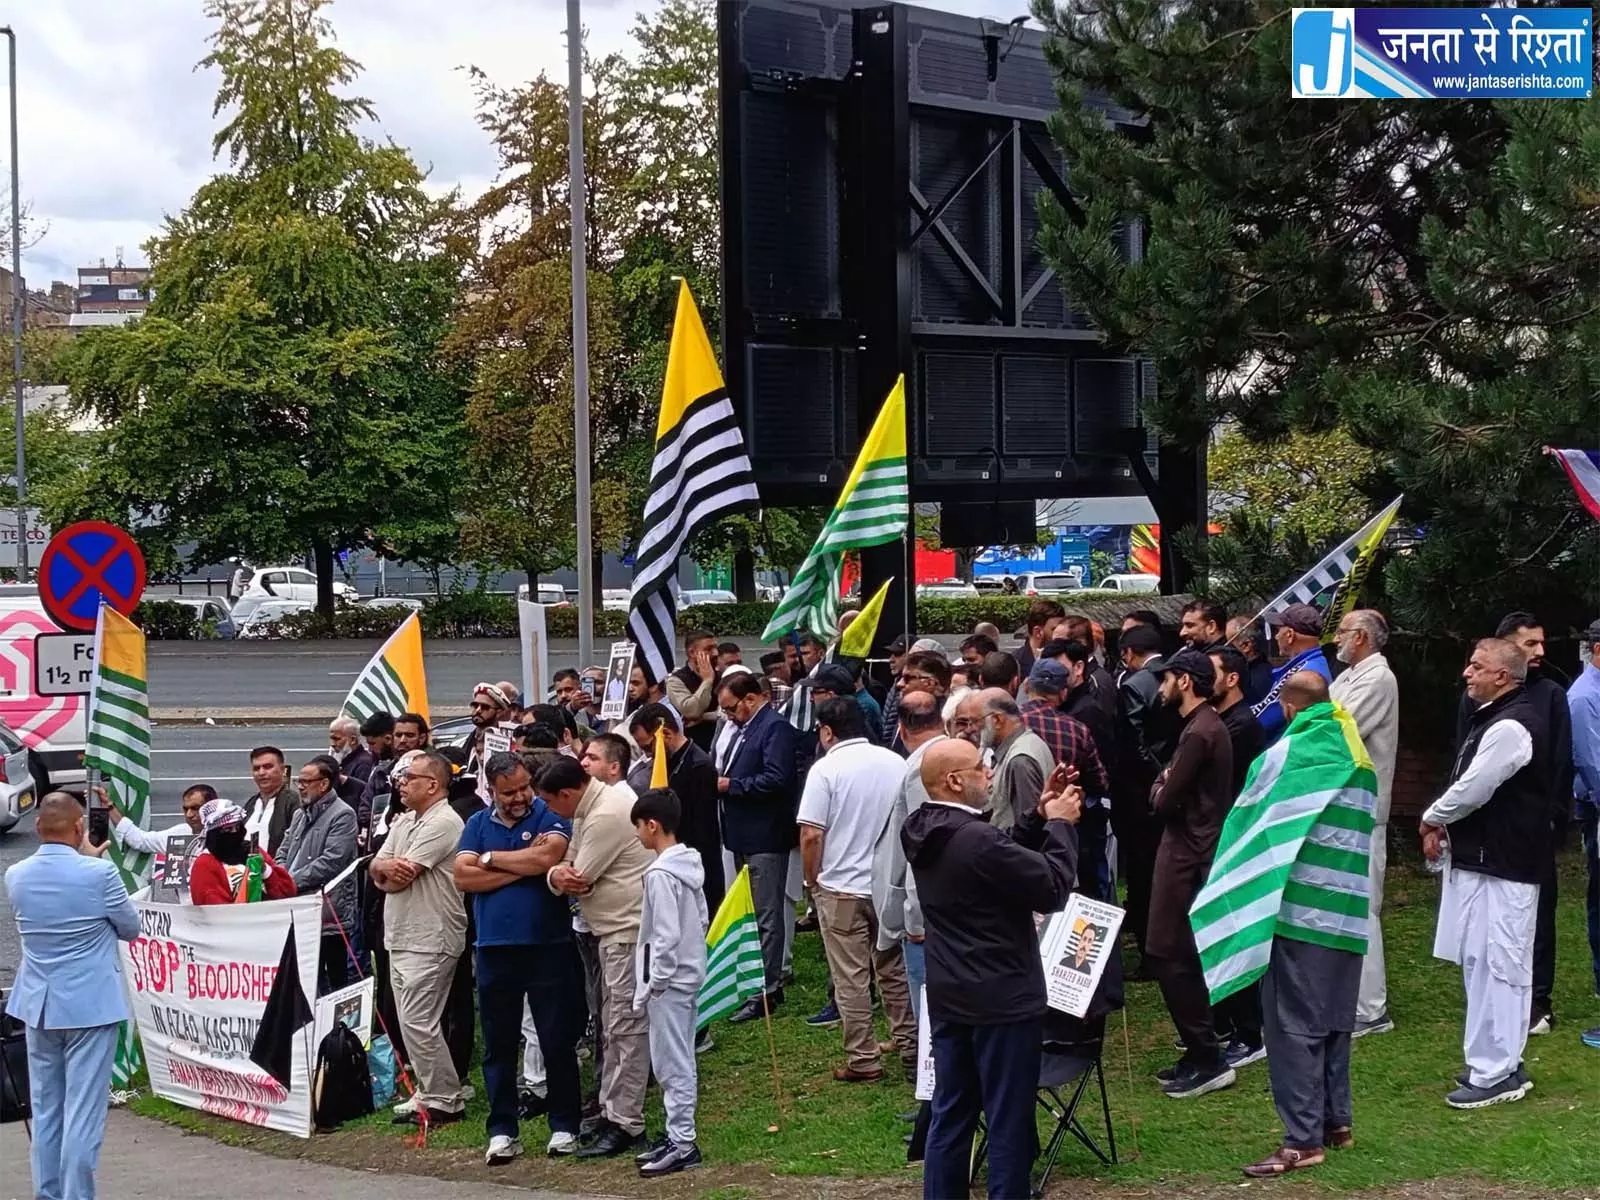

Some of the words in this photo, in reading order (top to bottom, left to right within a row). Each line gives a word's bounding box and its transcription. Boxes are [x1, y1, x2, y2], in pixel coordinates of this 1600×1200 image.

[1, 530, 45, 540] TECO
[74, 643, 95, 660] Fo
[129, 938, 179, 993] STOP
[180, 944, 195, 962] THE
